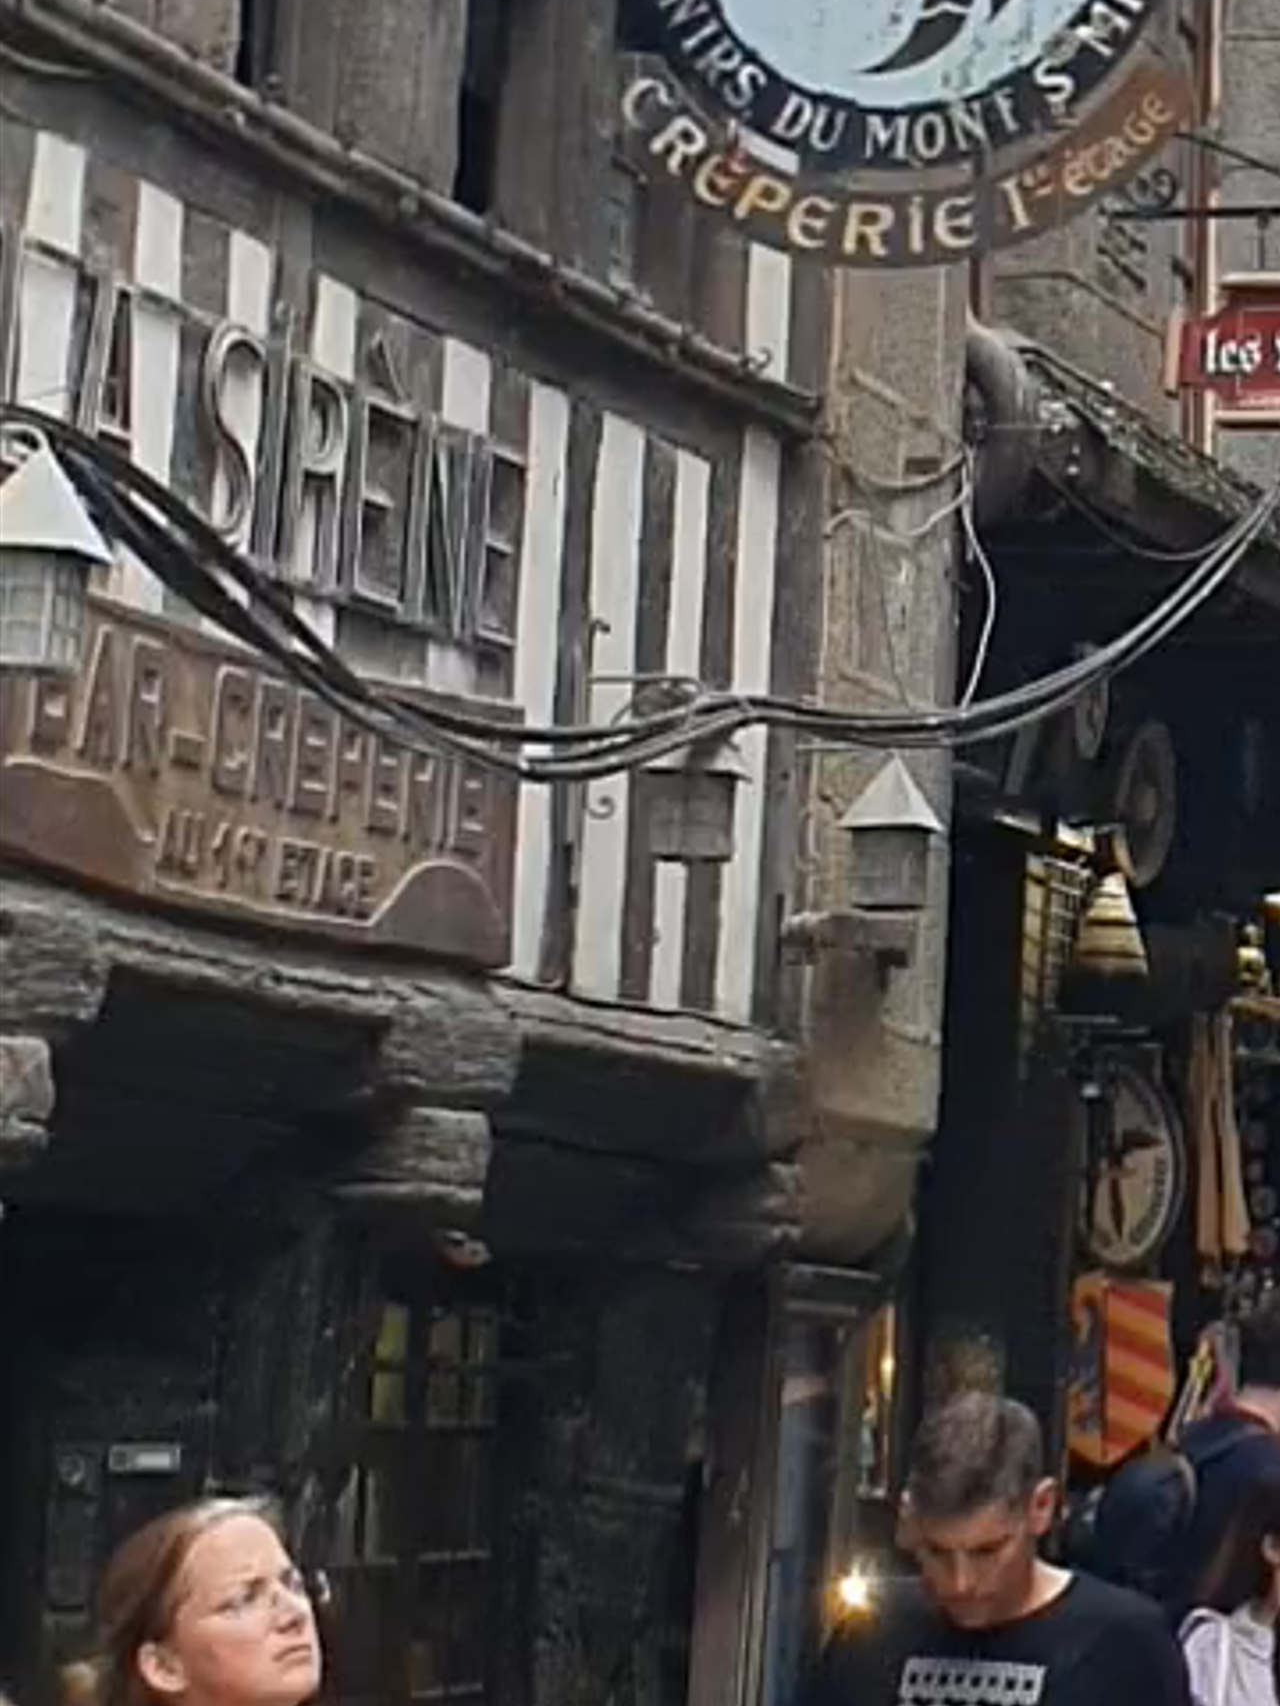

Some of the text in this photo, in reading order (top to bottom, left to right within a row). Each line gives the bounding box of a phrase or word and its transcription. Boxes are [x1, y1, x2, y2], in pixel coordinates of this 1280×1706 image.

[770, 91, 848, 153] DU
[863, 85, 1022, 160] MONT
[1206, 328, 1263, 374] les
